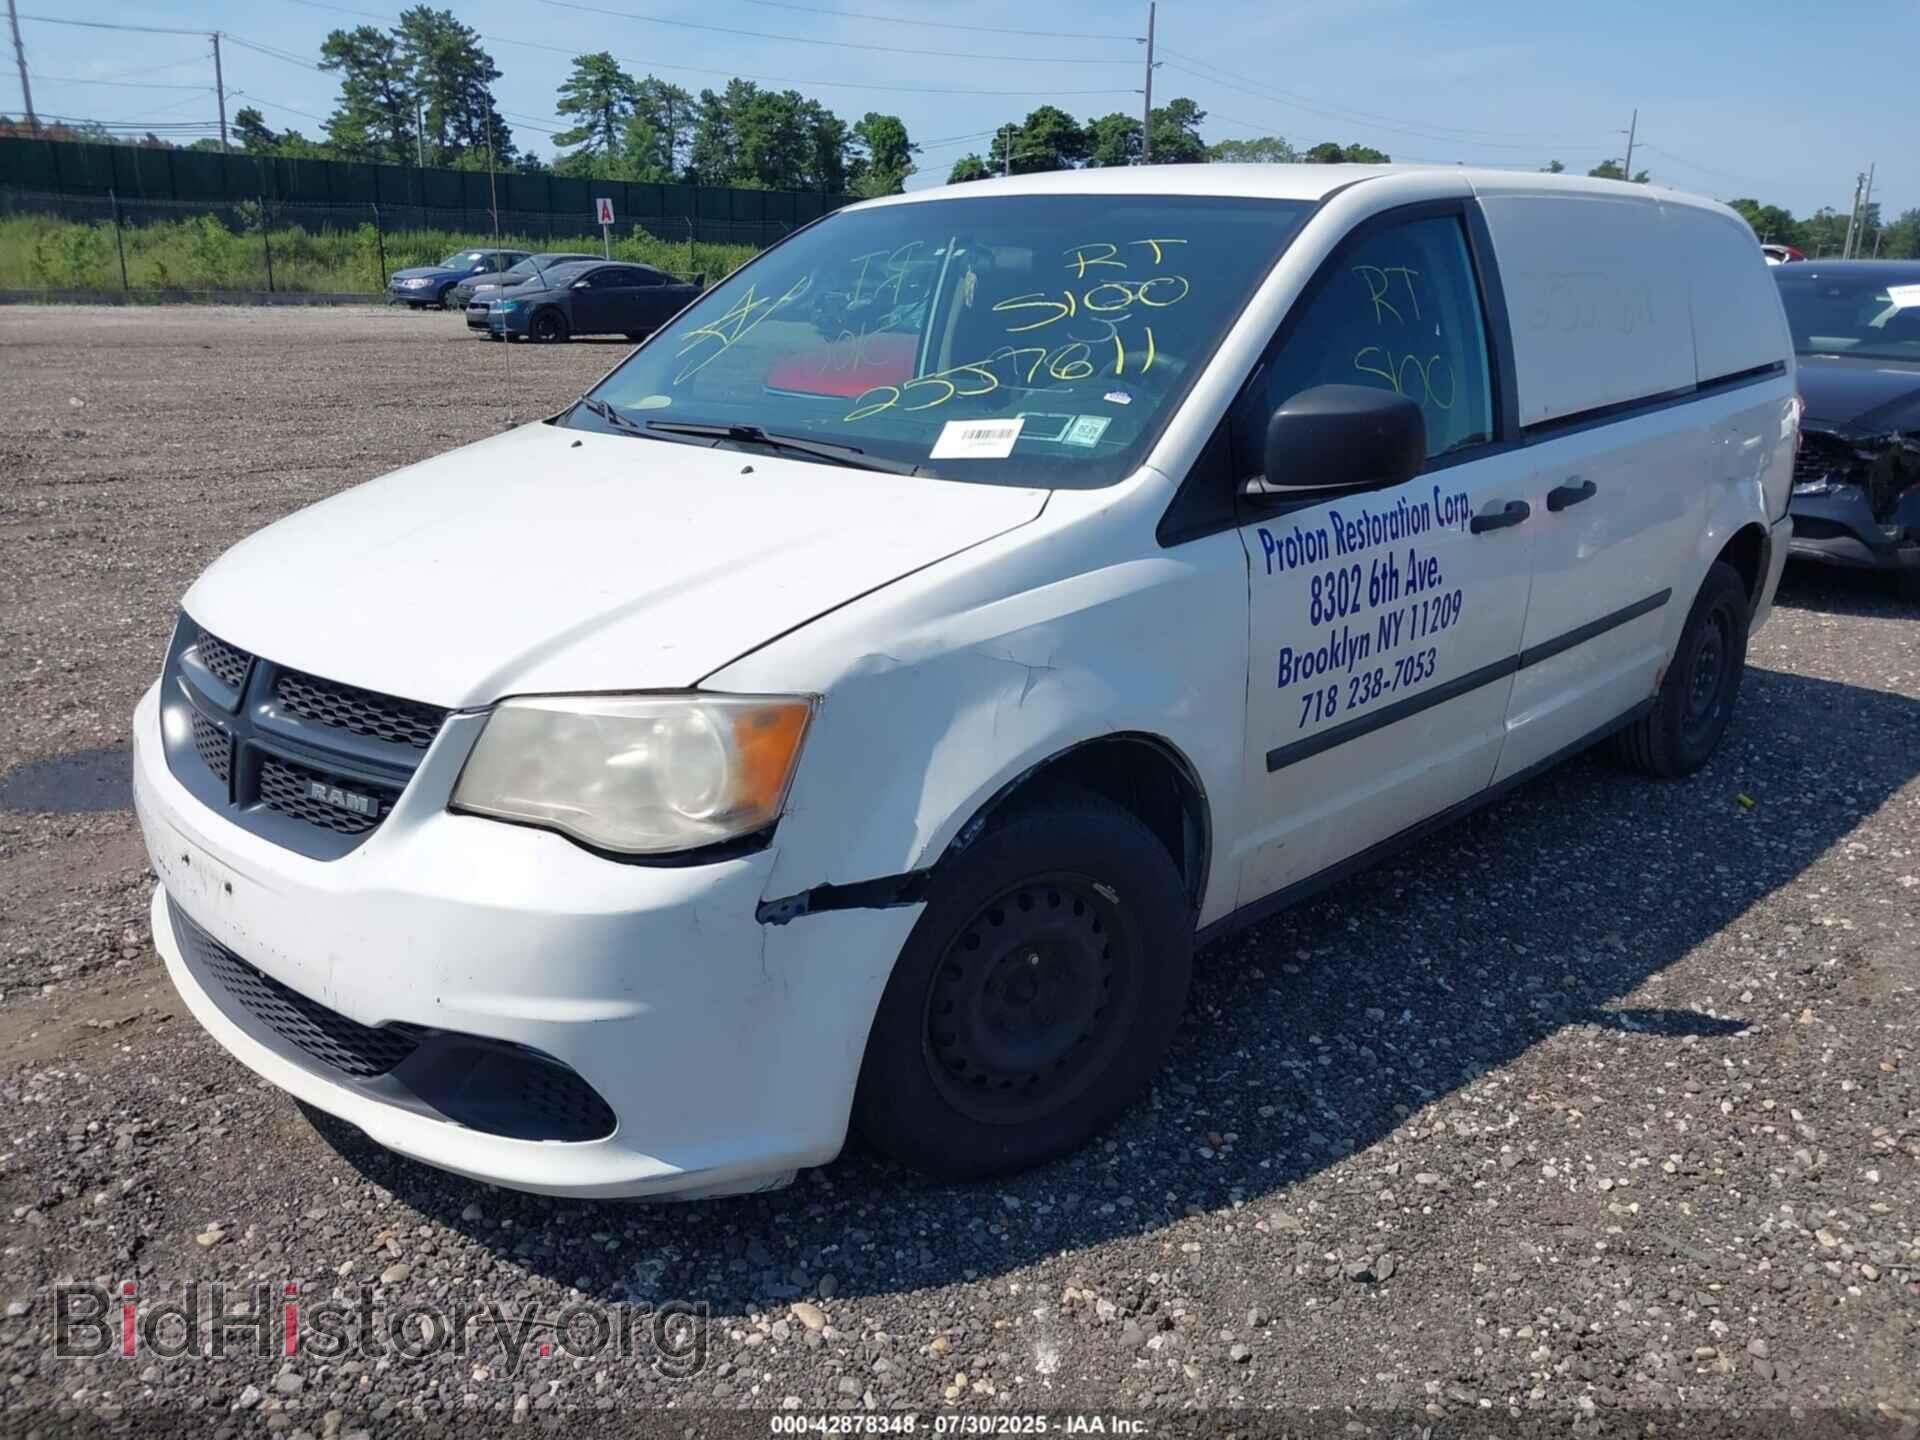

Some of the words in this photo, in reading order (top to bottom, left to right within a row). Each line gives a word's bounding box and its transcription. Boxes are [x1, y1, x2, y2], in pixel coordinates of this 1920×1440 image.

[602, 201, 610, 220] A
[1257, 526, 1329, 575] Proton
[1329, 496, 1431, 556] Restoration
[1433, 485, 1474, 532] Corp.
[1310, 563, 1362, 627] 8302
[1369, 551, 1399, 608] 6th
[1404, 548, 1442, 597] Ave.
[1278, 625, 1370, 688] Brooklyn
[1376, 609, 1405, 653] NY
[1409, 589, 1463, 641] 11209
[1299, 684, 1338, 728] 718
[1346, 647, 1437, 710] 238-7053
[311, 783, 369, 812] RAM
